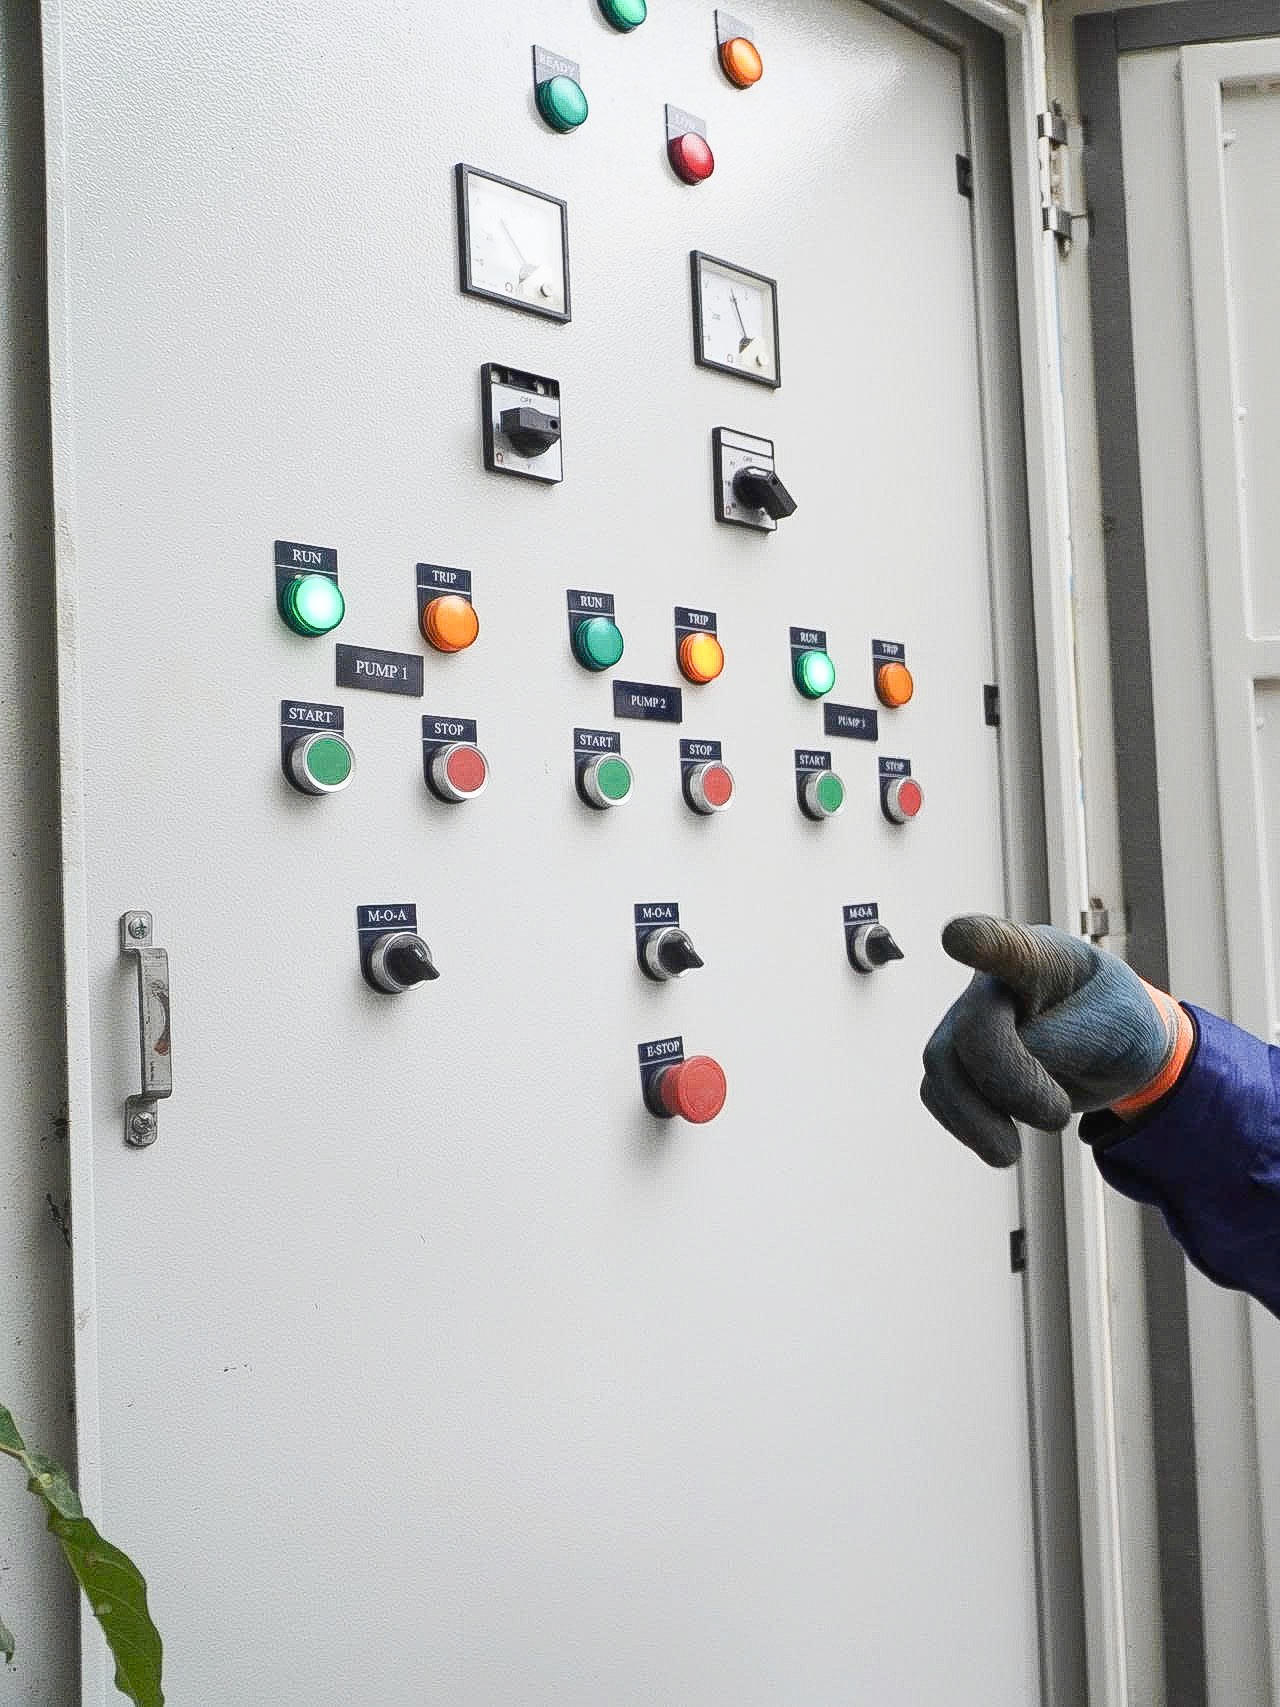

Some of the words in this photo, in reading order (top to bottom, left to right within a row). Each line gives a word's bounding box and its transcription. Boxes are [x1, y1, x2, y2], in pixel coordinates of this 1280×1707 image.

[292, 548, 322, 564] RUN
[431, 568, 457, 584] TRIP
[579, 595, 603, 608] RUN
[687, 612, 709, 626] TRIP
[799, 631, 818, 644] RUN
[881, 643, 899, 655] TRIP
[355, 659, 399, 679] PUMP
[401, 666, 409, 681] 1
[631, 694, 659, 708] PUMP
[660, 697, 667, 709] 2
[288, 706, 334, 724] START
[837, 715, 861, 728] PUMP
[433, 722, 465, 736] STOP
[579, 733, 613, 748] START
[688, 743, 713, 756] STOP
[799, 753, 826, 767] START
[885, 760, 904, 771] STOP
[367, 908, 408, 922] M-O-A
[642, 906, 673, 919] M-O-A
[646, 1040, 680, 1057] E-STOP
